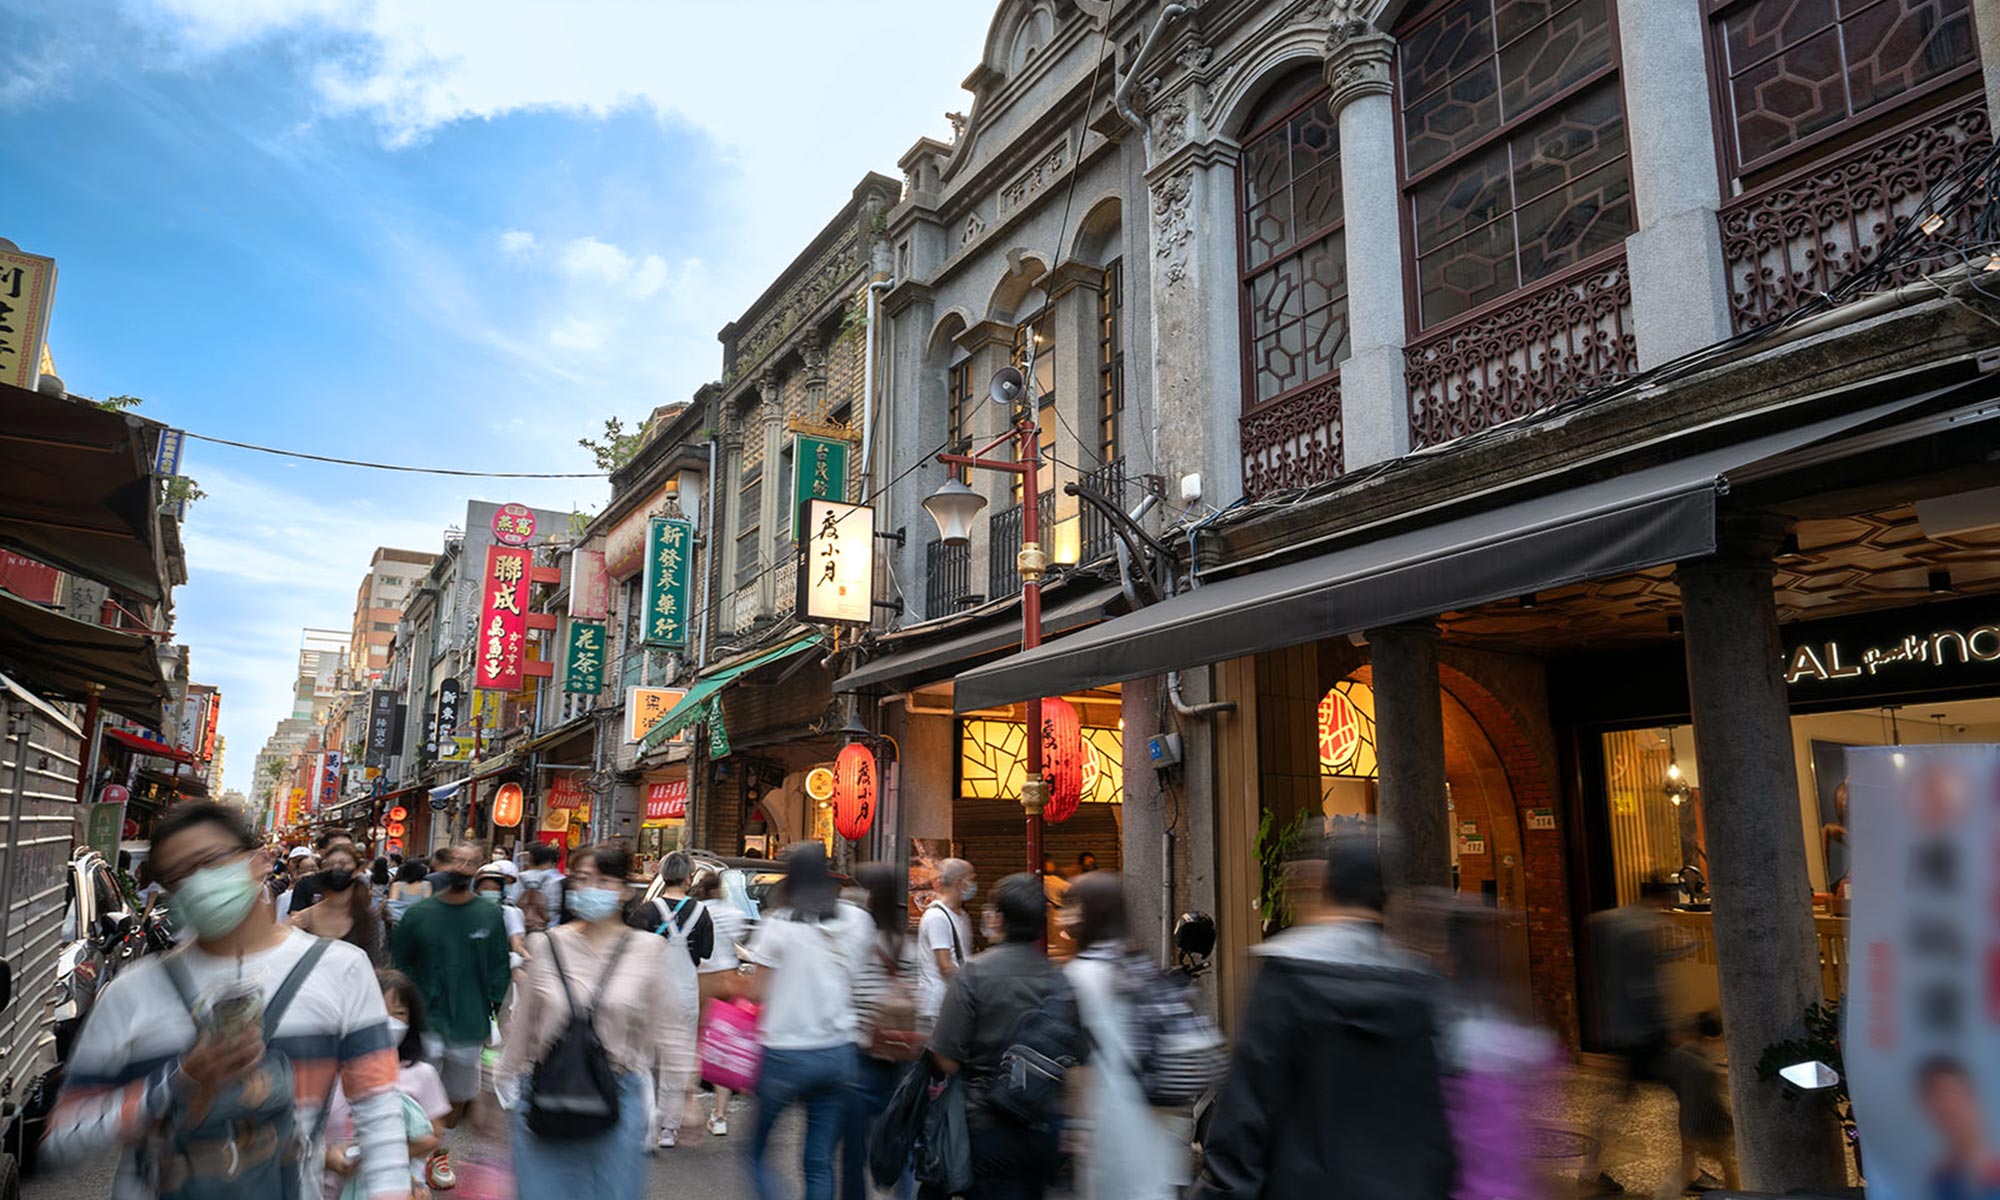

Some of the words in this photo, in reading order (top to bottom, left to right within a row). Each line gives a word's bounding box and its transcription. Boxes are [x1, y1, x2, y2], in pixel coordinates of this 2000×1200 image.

[496, 514, 533, 537] 燕窩
[817, 509, 840, 588] 度小月
[504, 631, 522, 677] からすみ
[571, 627, 600, 673] 花茶
[1782, 641, 1862, 684] AL
[854, 760, 872, 825] 度小月
